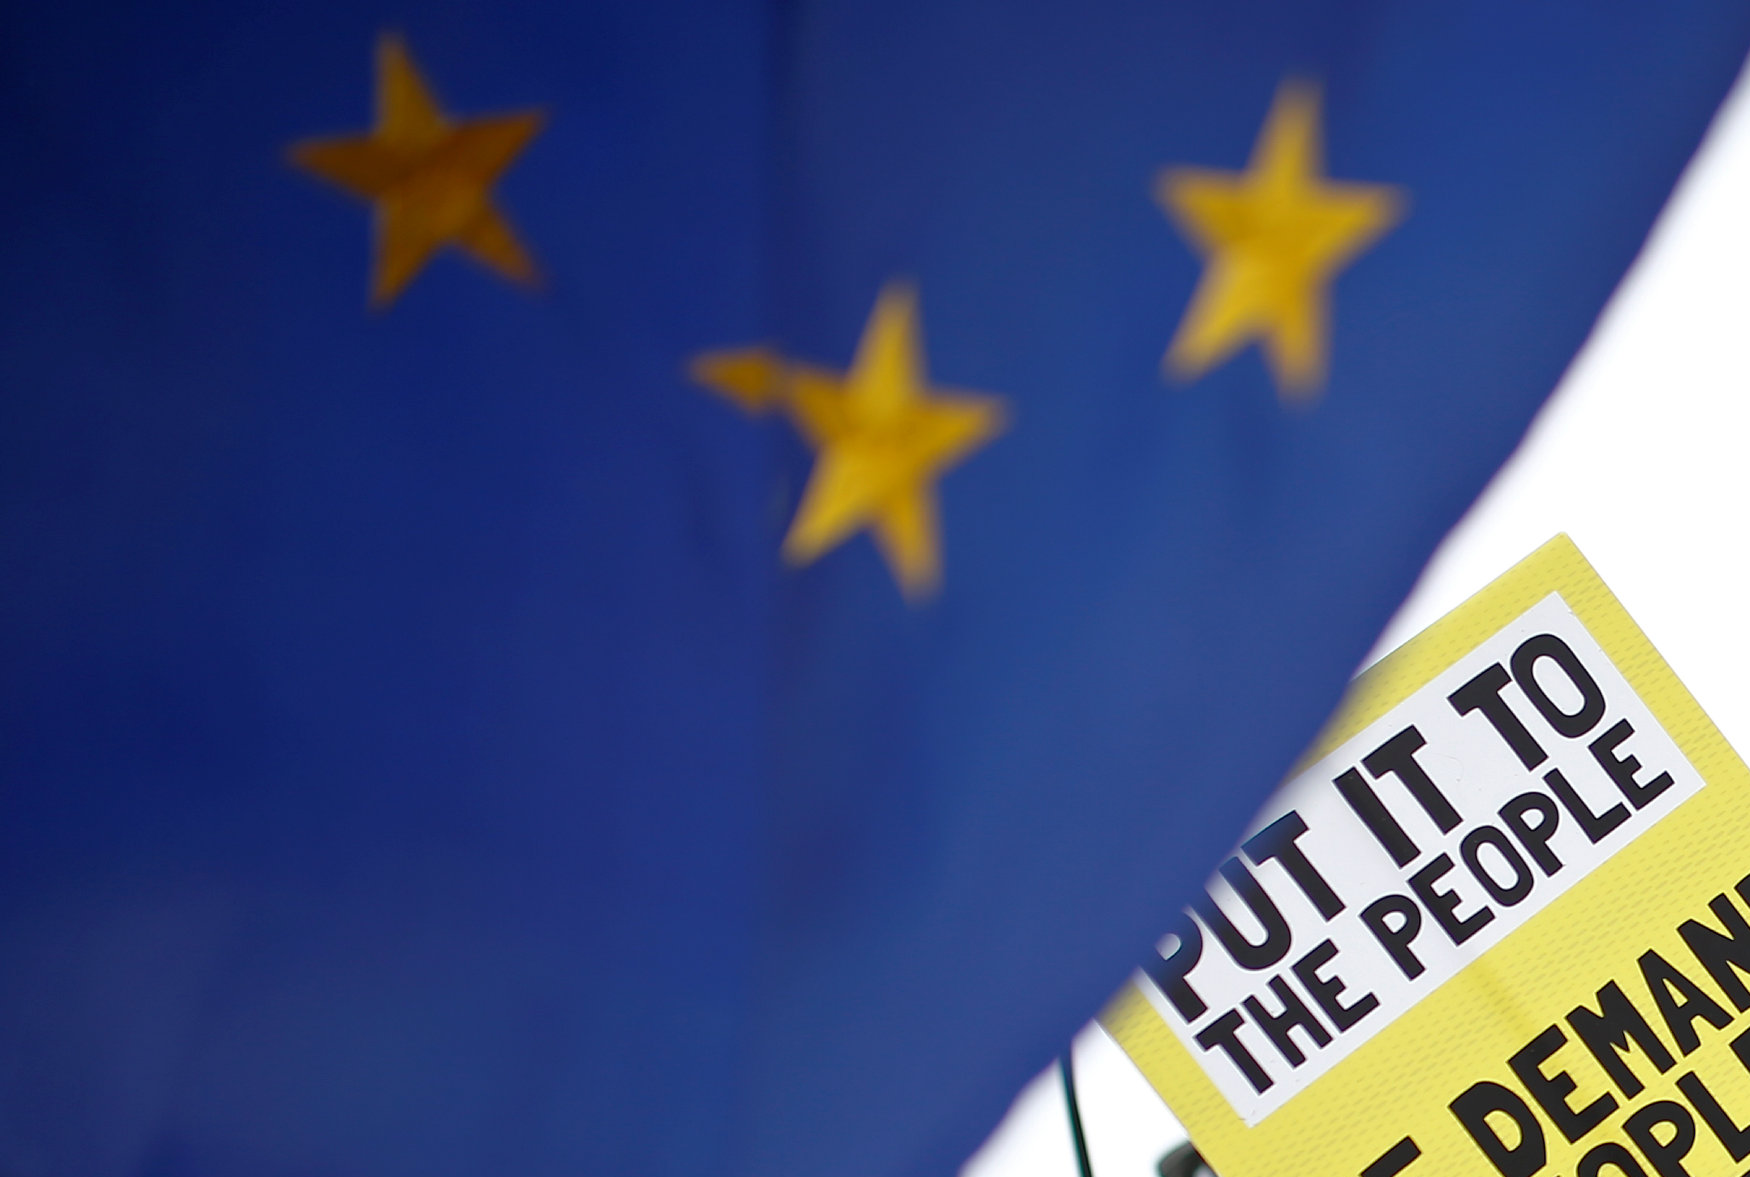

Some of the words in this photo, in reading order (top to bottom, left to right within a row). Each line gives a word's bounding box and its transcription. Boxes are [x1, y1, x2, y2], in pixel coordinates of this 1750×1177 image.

[1130, 809, 1347, 1025] PUT
[1331, 725, 1463, 869] IT
[1447, 633, 1606, 772] TO
[1194, 938, 1380, 1095] THE
[1359, 718, 1675, 981] PEOPLE
